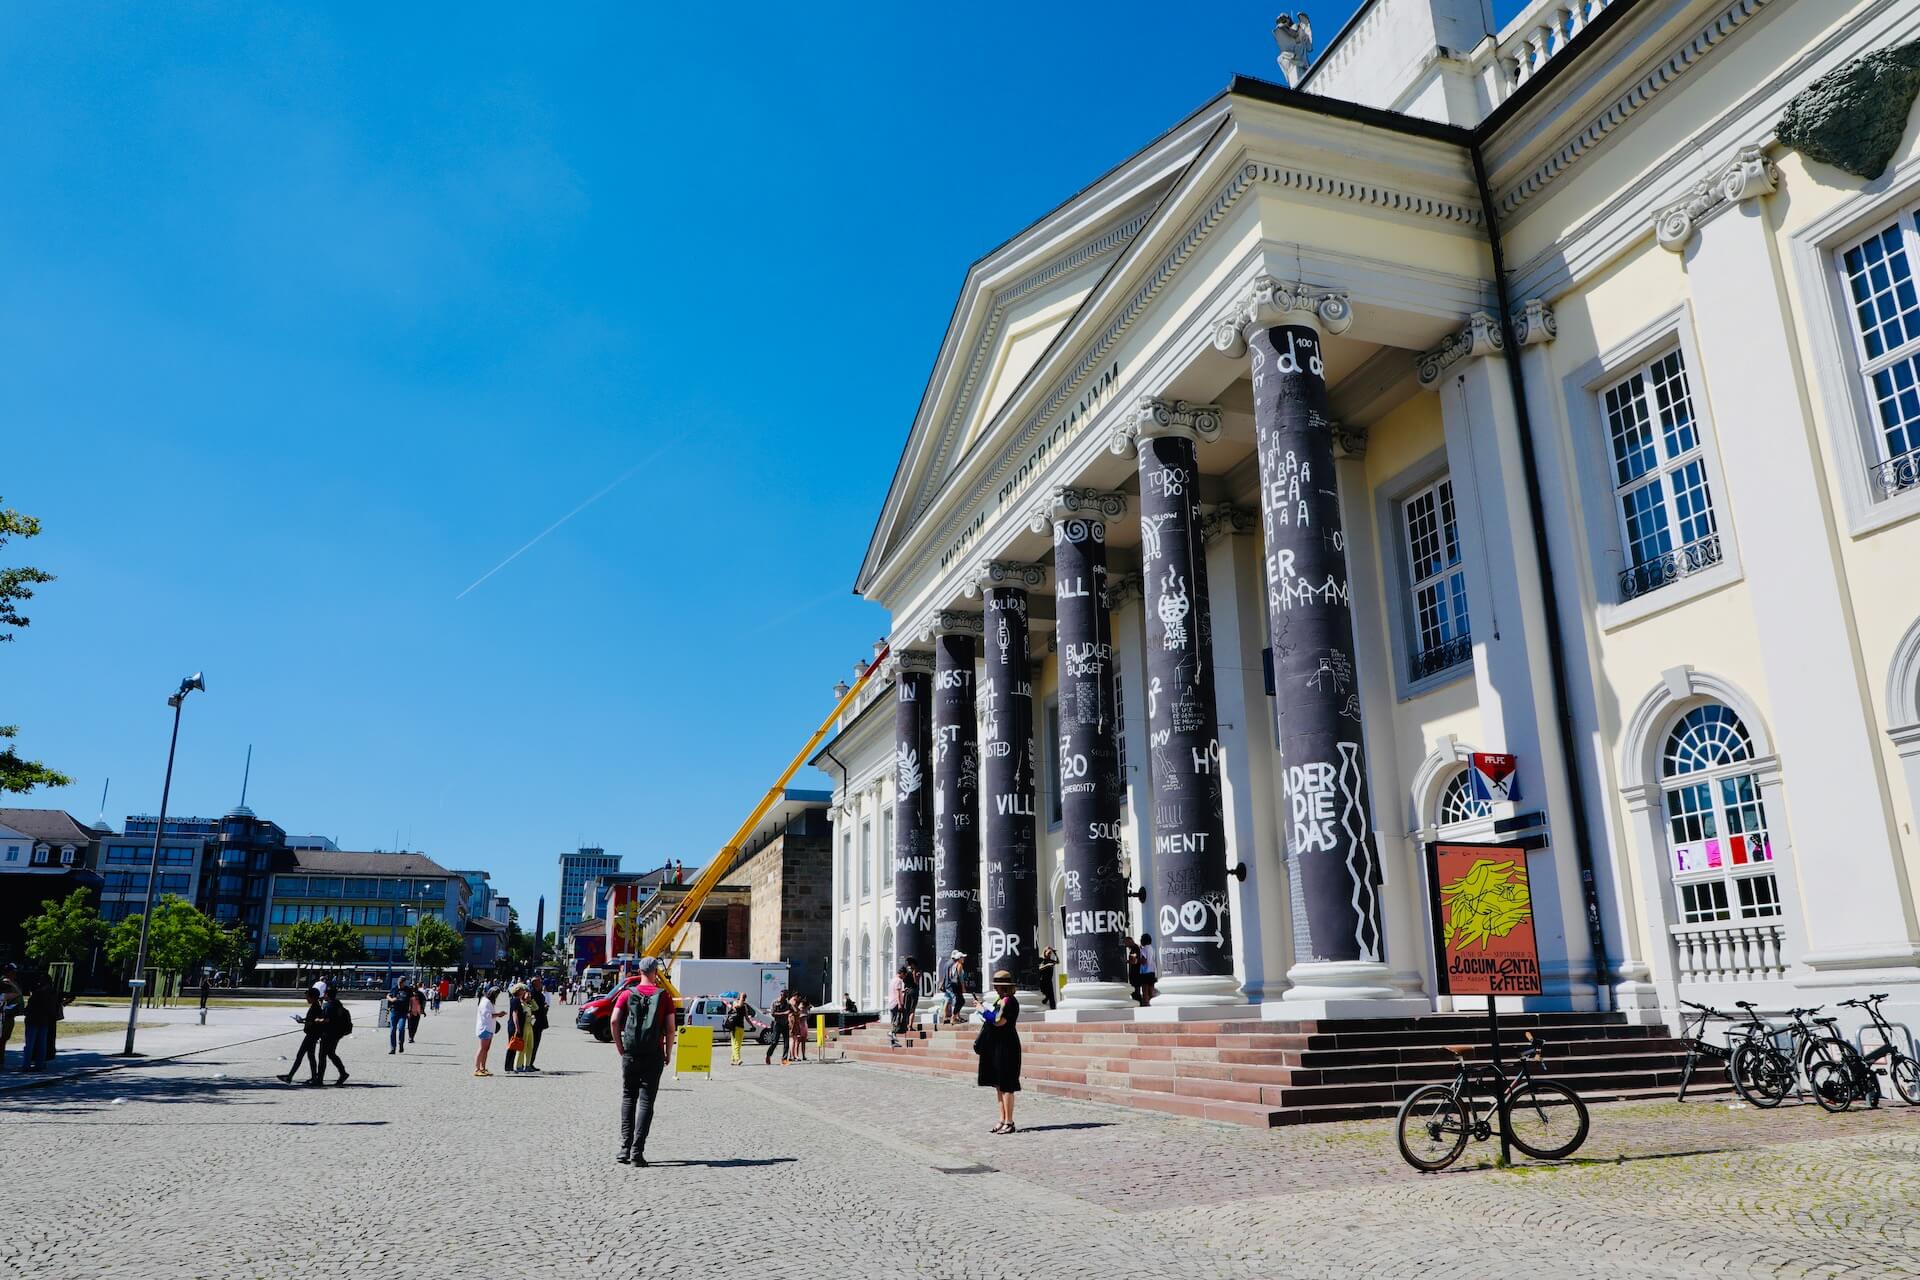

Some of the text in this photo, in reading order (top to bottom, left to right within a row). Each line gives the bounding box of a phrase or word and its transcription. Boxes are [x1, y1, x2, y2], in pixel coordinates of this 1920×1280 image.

[1148, 468, 1190, 488] TODOS
[1293, 791, 1336, 824] DIE
[1295, 821, 1337, 854] DAS
